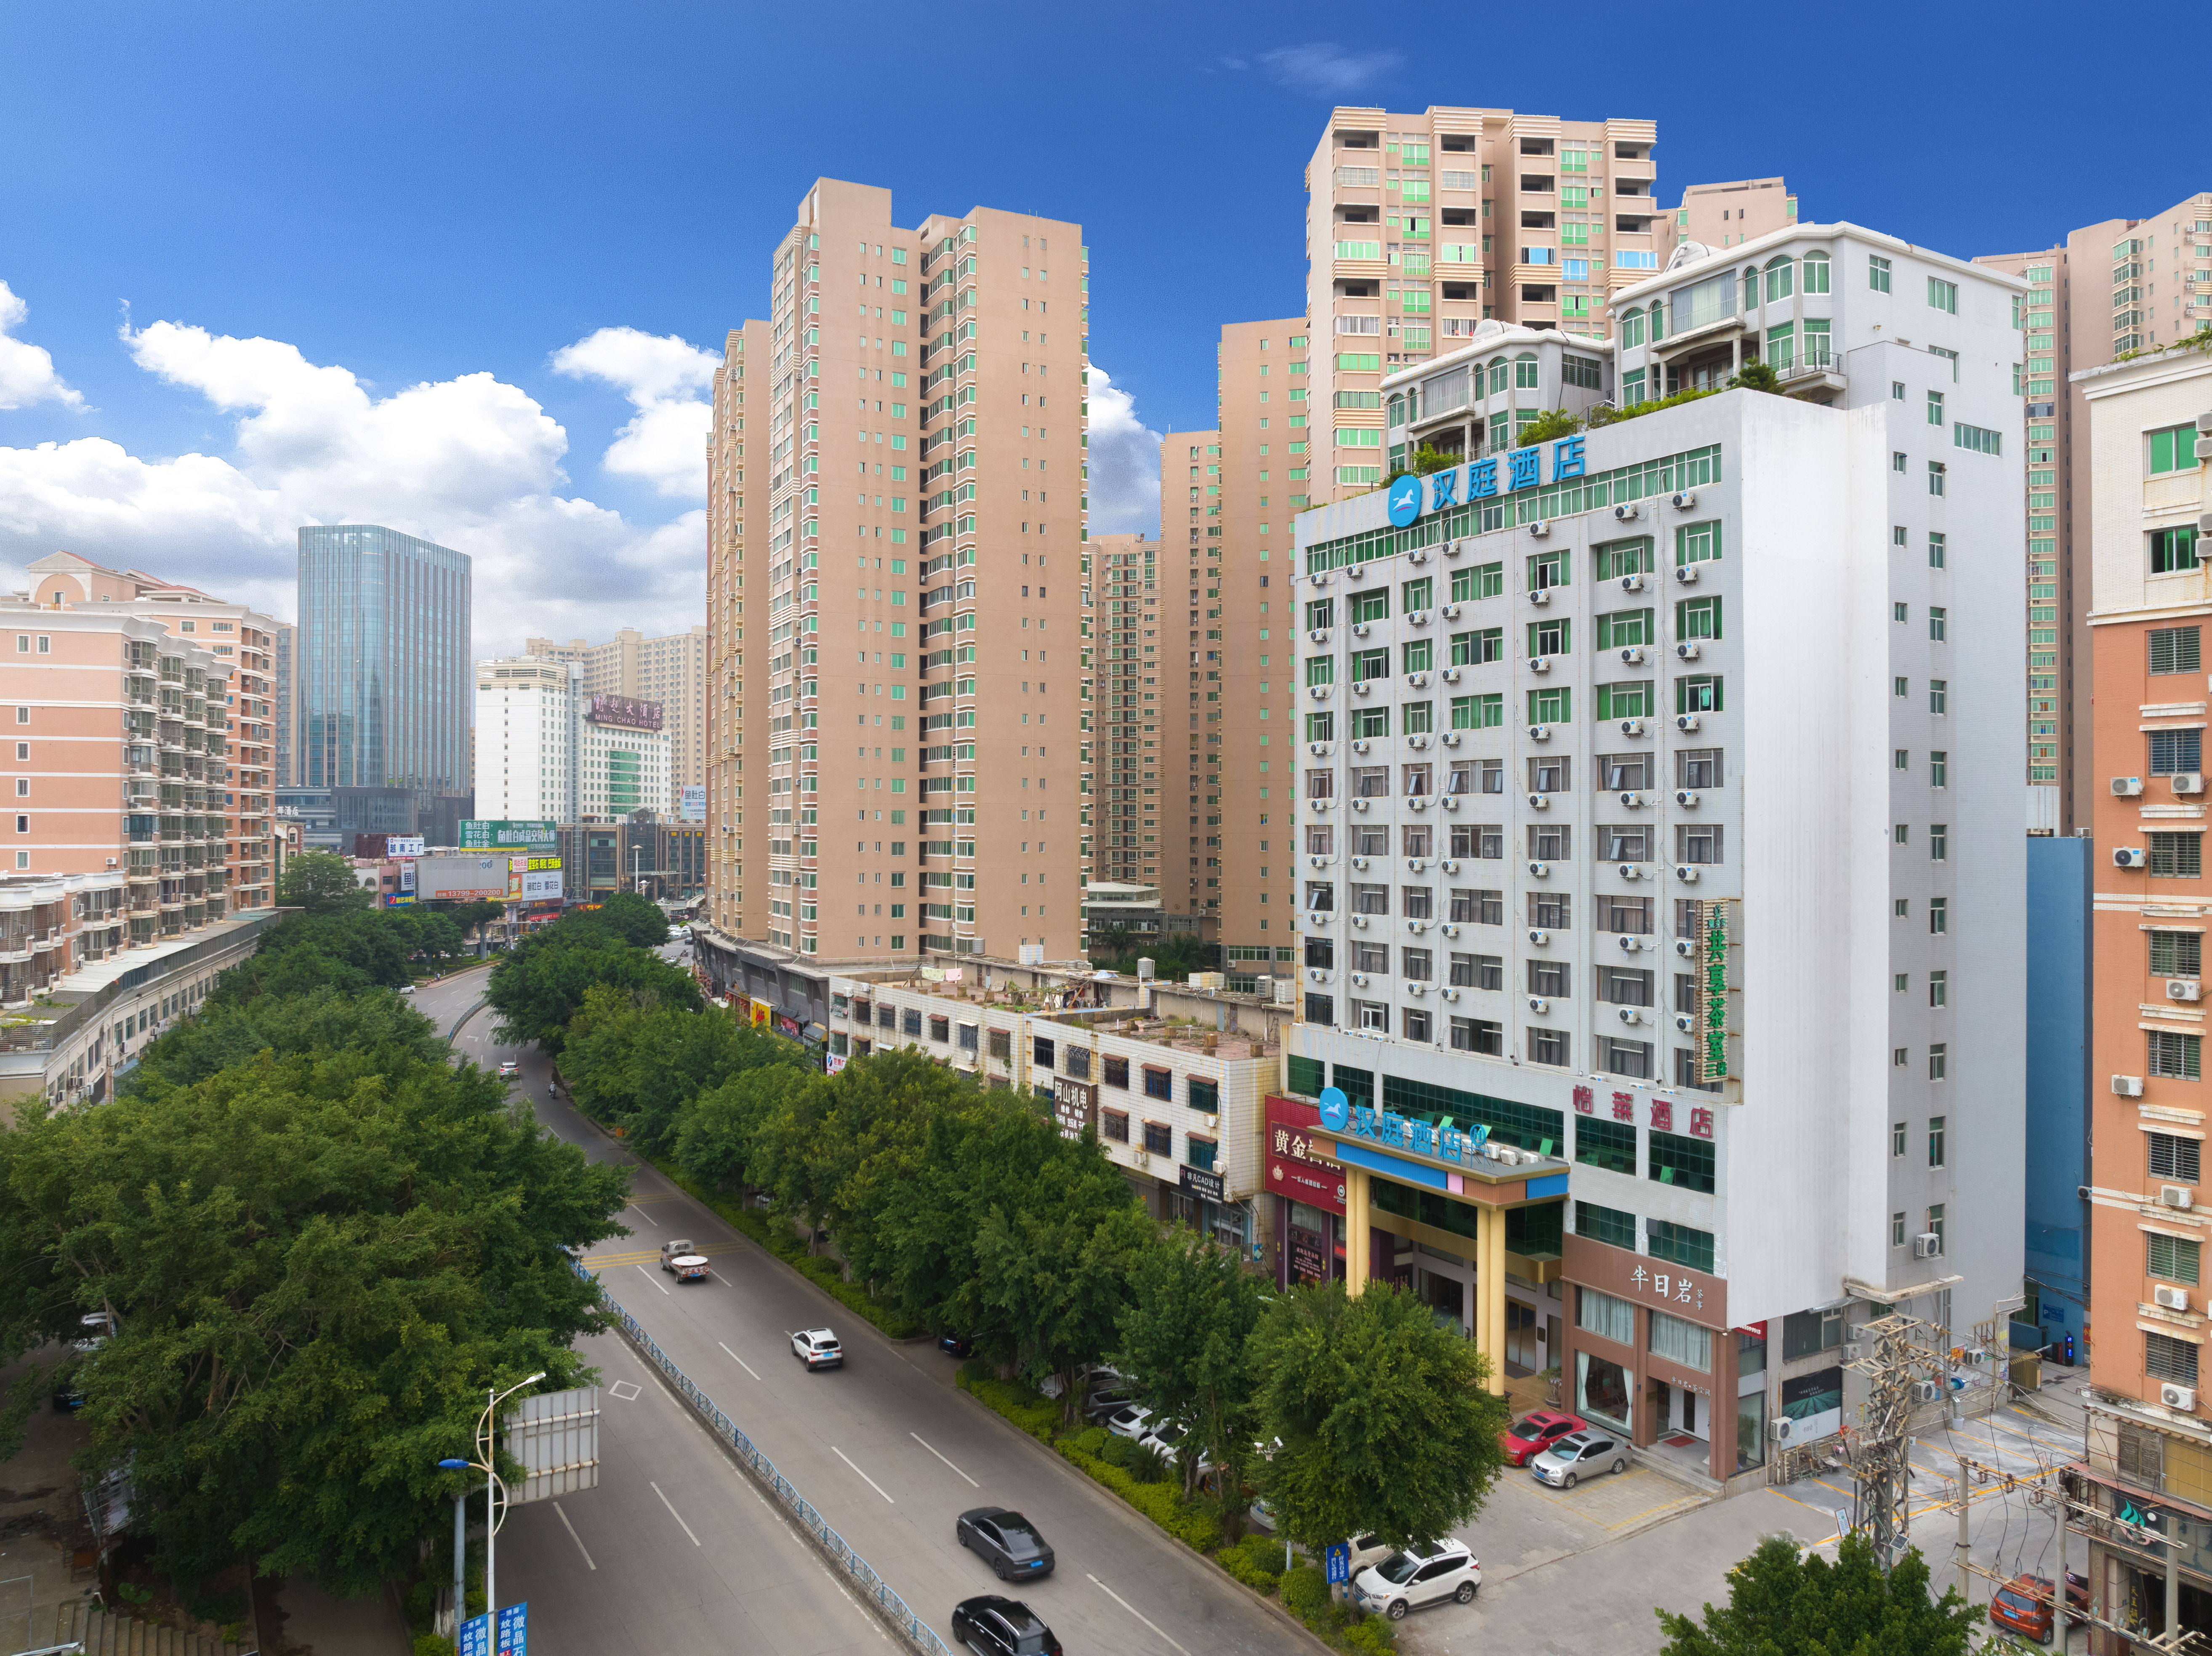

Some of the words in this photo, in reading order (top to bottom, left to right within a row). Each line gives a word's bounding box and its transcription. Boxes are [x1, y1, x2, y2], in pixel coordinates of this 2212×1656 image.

[1432, 436, 1585, 510] 汉庭酒店
[595, 714, 613, 722] MING
[639, 720, 660, 728] HOTEL
[684, 790, 705, 799] 鱼肚白
[390, 843, 423, 853] 越南工厂
[527, 881, 542, 891] 鱼肚白
[544, 880, 559, 890] 雪花白
[1055, 1081, 1088, 1110] 阿山机电
[1061, 1104, 1070, 1114] 维修
[1074, 1108, 1083, 1119] 销售
[1573, 1085, 1712, 1138] 怡莱酒店
[1067, 1117, 1077, 1129] 空压机
[1355, 1105, 1461, 1162] 汉庭酒店
[1187, 1171, 1220, 1190] 非凡CAD设计
[1630, 1265, 1693, 1303] 半日岩
[500, 1619, 511, 1649] 纹路板
